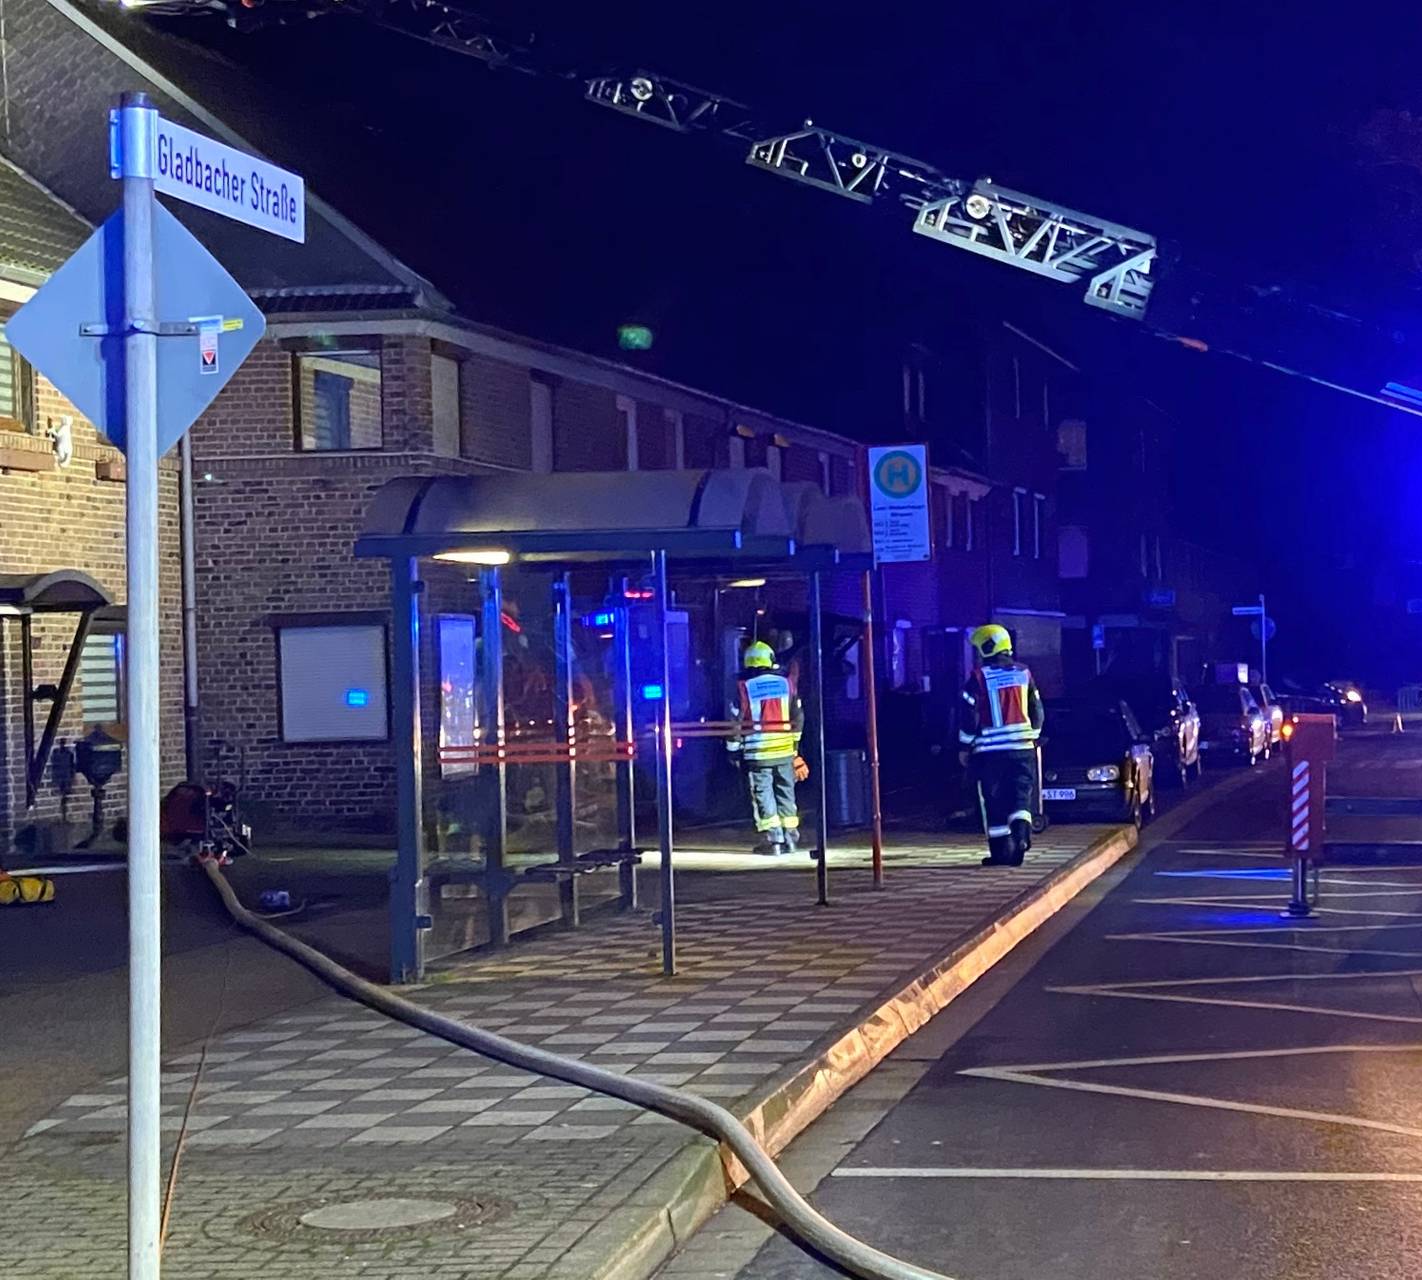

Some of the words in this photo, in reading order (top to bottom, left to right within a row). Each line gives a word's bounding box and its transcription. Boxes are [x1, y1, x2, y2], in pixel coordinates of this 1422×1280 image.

[158, 134, 246, 205] Gladbacher
[251, 171, 297, 223] Straße
[888, 463, 910, 488] H
